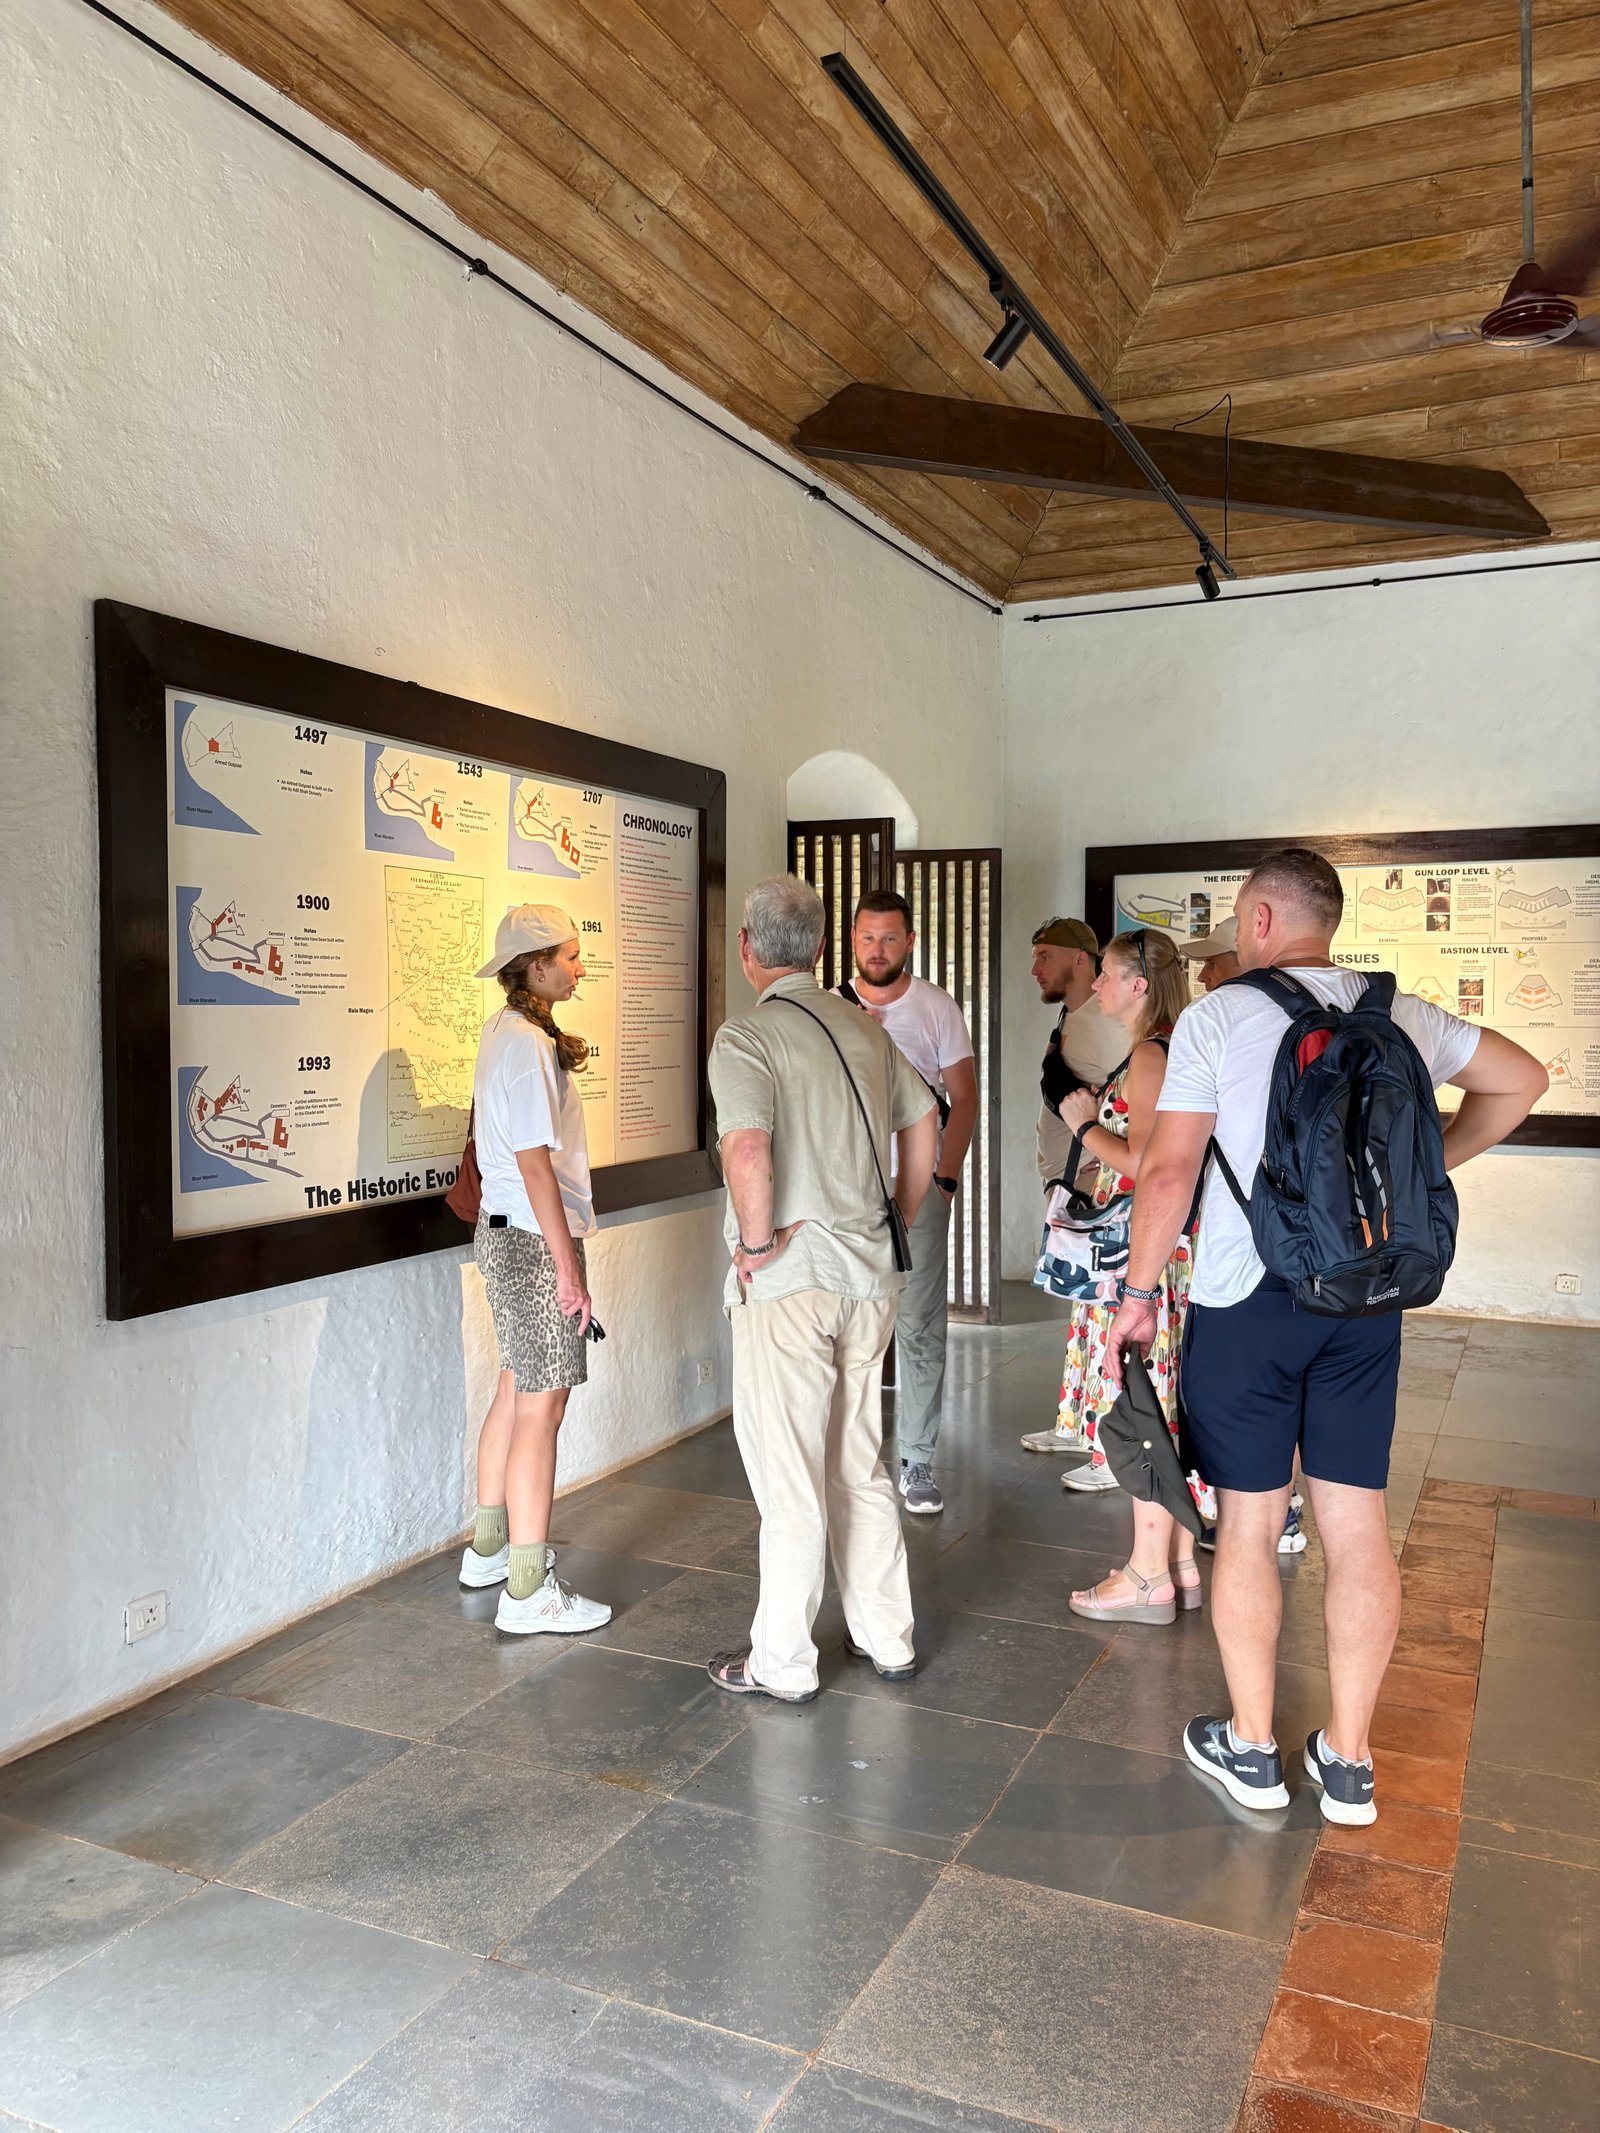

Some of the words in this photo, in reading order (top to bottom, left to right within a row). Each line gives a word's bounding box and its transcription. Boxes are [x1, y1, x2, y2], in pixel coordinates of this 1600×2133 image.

[294, 725, 328, 745] 1497
[300, 768, 312, 776] Notes
[457, 761, 483, 778] 1543
[583, 790, 603, 804] 1707
[623, 813, 692, 840] CHRONOLOGY
[296, 894, 330, 910] 1900
[582, 920, 602, 932] 1961
[1332, 954, 1380, 964] ISSUES
[298, 1056, 330, 1072] 1993
[304, 1185, 342, 1209] The
[348, 1172, 420, 1202] Historic
